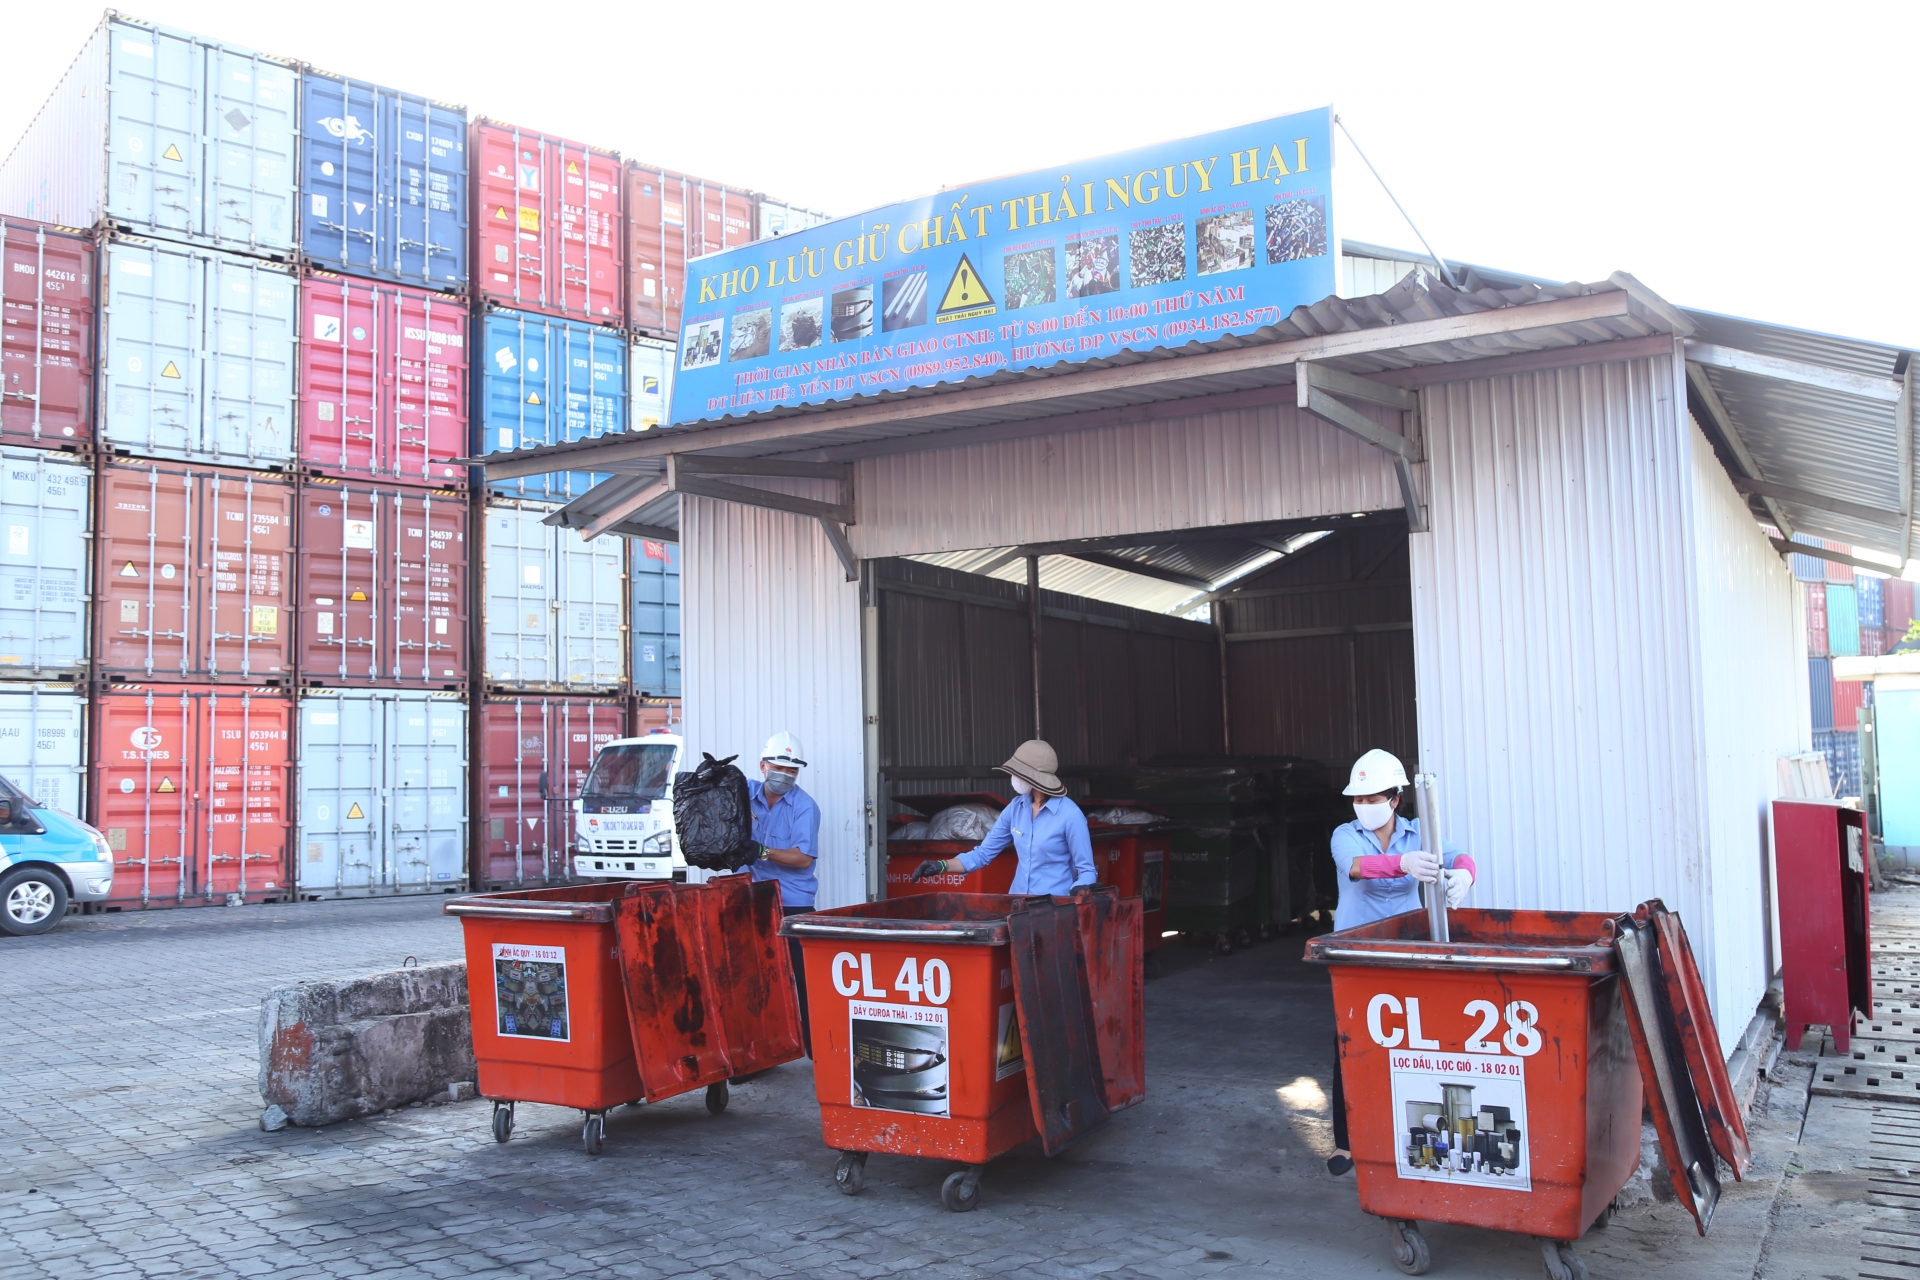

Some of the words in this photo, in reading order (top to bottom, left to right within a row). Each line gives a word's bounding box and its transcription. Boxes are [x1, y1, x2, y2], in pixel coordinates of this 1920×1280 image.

[697, 264, 760, 304] KHO
[766, 246, 826, 288] LƯU
[833, 222, 892, 271] GIỮ
[897, 193, 993, 255] CHẤT
[1001, 174, 1096, 232] THẢI
[1105, 156, 1220, 211] NGUY
[1230, 137, 1311, 187] HẠI
[14, 262, 36, 275] BMOU
[45, 268, 77, 282] 442616
[46, 281, 65, 291] 45G1
[939, 315, 953, 323] CHẤT
[968, 310, 982, 318] NGUY
[404, 326, 426, 341] NSSU
[734, 366, 771, 387] THỜI
[774, 361, 812, 380] GIAN
[814, 352, 858, 375] NHẬN
[897, 338, 938, 358] GIAO
[942, 329, 996, 350] CTNH:
[998, 320, 1023, 341] TỪ
[1027, 318, 1059, 335] 8:00
[1062, 305, 1102, 330] ĐẾN
[1106, 303, 1150, 323] 10:00
[1151, 290, 1193, 315] THỨ
[1197, 286, 1245, 308] NĂM
[707, 395, 726, 411] ĐT
[729, 388, 767, 409] LIÊN
[799, 375, 831, 398] YẾN
[834, 376, 856, 392] ĐT
[859, 367, 900, 386] VSCN
[1011, 339, 1076, 363] HƯƠNG
[1079, 334, 1106, 351] ĐP
[1108, 325, 1158, 347] VSCN
[1161, 306, 1280, 340] (0934.182.877)
[12, 471, 37, 483] MRKU
[47, 475, 63, 486] 432
[47, 485, 66, 496] 45G1
[226, 511, 244, 522] TCNU
[252, 514, 279, 525] 735584
[252, 525, 270, 535] 45G1
[430, 530, 453, 541] 346539
[597, 538, 610, 546] 45G1
[38, 728, 65, 738] 168999
[221, 730, 241, 740] TSLU
[250, 730, 279, 740] 053944
[37, 741, 56, 750] 45G1
[249, 742, 269, 752] 45G1
[214, 798, 226, 807] NET
[601, 805, 628, 814] ISUZU
[947, 874, 965, 887] ĐẸP
[535, 950, 541, 958] 16
[542, 951, 549, 959] 01
[550, 951, 557, 959] 12
[832, 951, 887, 997] CL
[895, 957, 952, 1005] 40
[854, 1005, 867, 1016] DÂY
[869, 1007, 891, 1019] CUROA
[892, 1007, 908, 1021] THẢI
[914, 1012, 922, 1021] 19
[925, 1013, 933, 1022] 12
[935, 1014, 944, 1023] 01
[1366, 993, 1440, 1050] CL
[1463, 999, 1543, 1057] 28
[1393, 1058, 1410, 1072] LỌC
[1413, 1054, 1434, 1073] DẦU,
[1437, 1060, 1454, 1074] LỌC
[1456, 1059, 1472, 1073] GIÓ
[1481, 1063, 1492, 1074] 18
[1494, 1064, 1506, 1075] 02
[1509, 1065, 1521, 1077] 01
